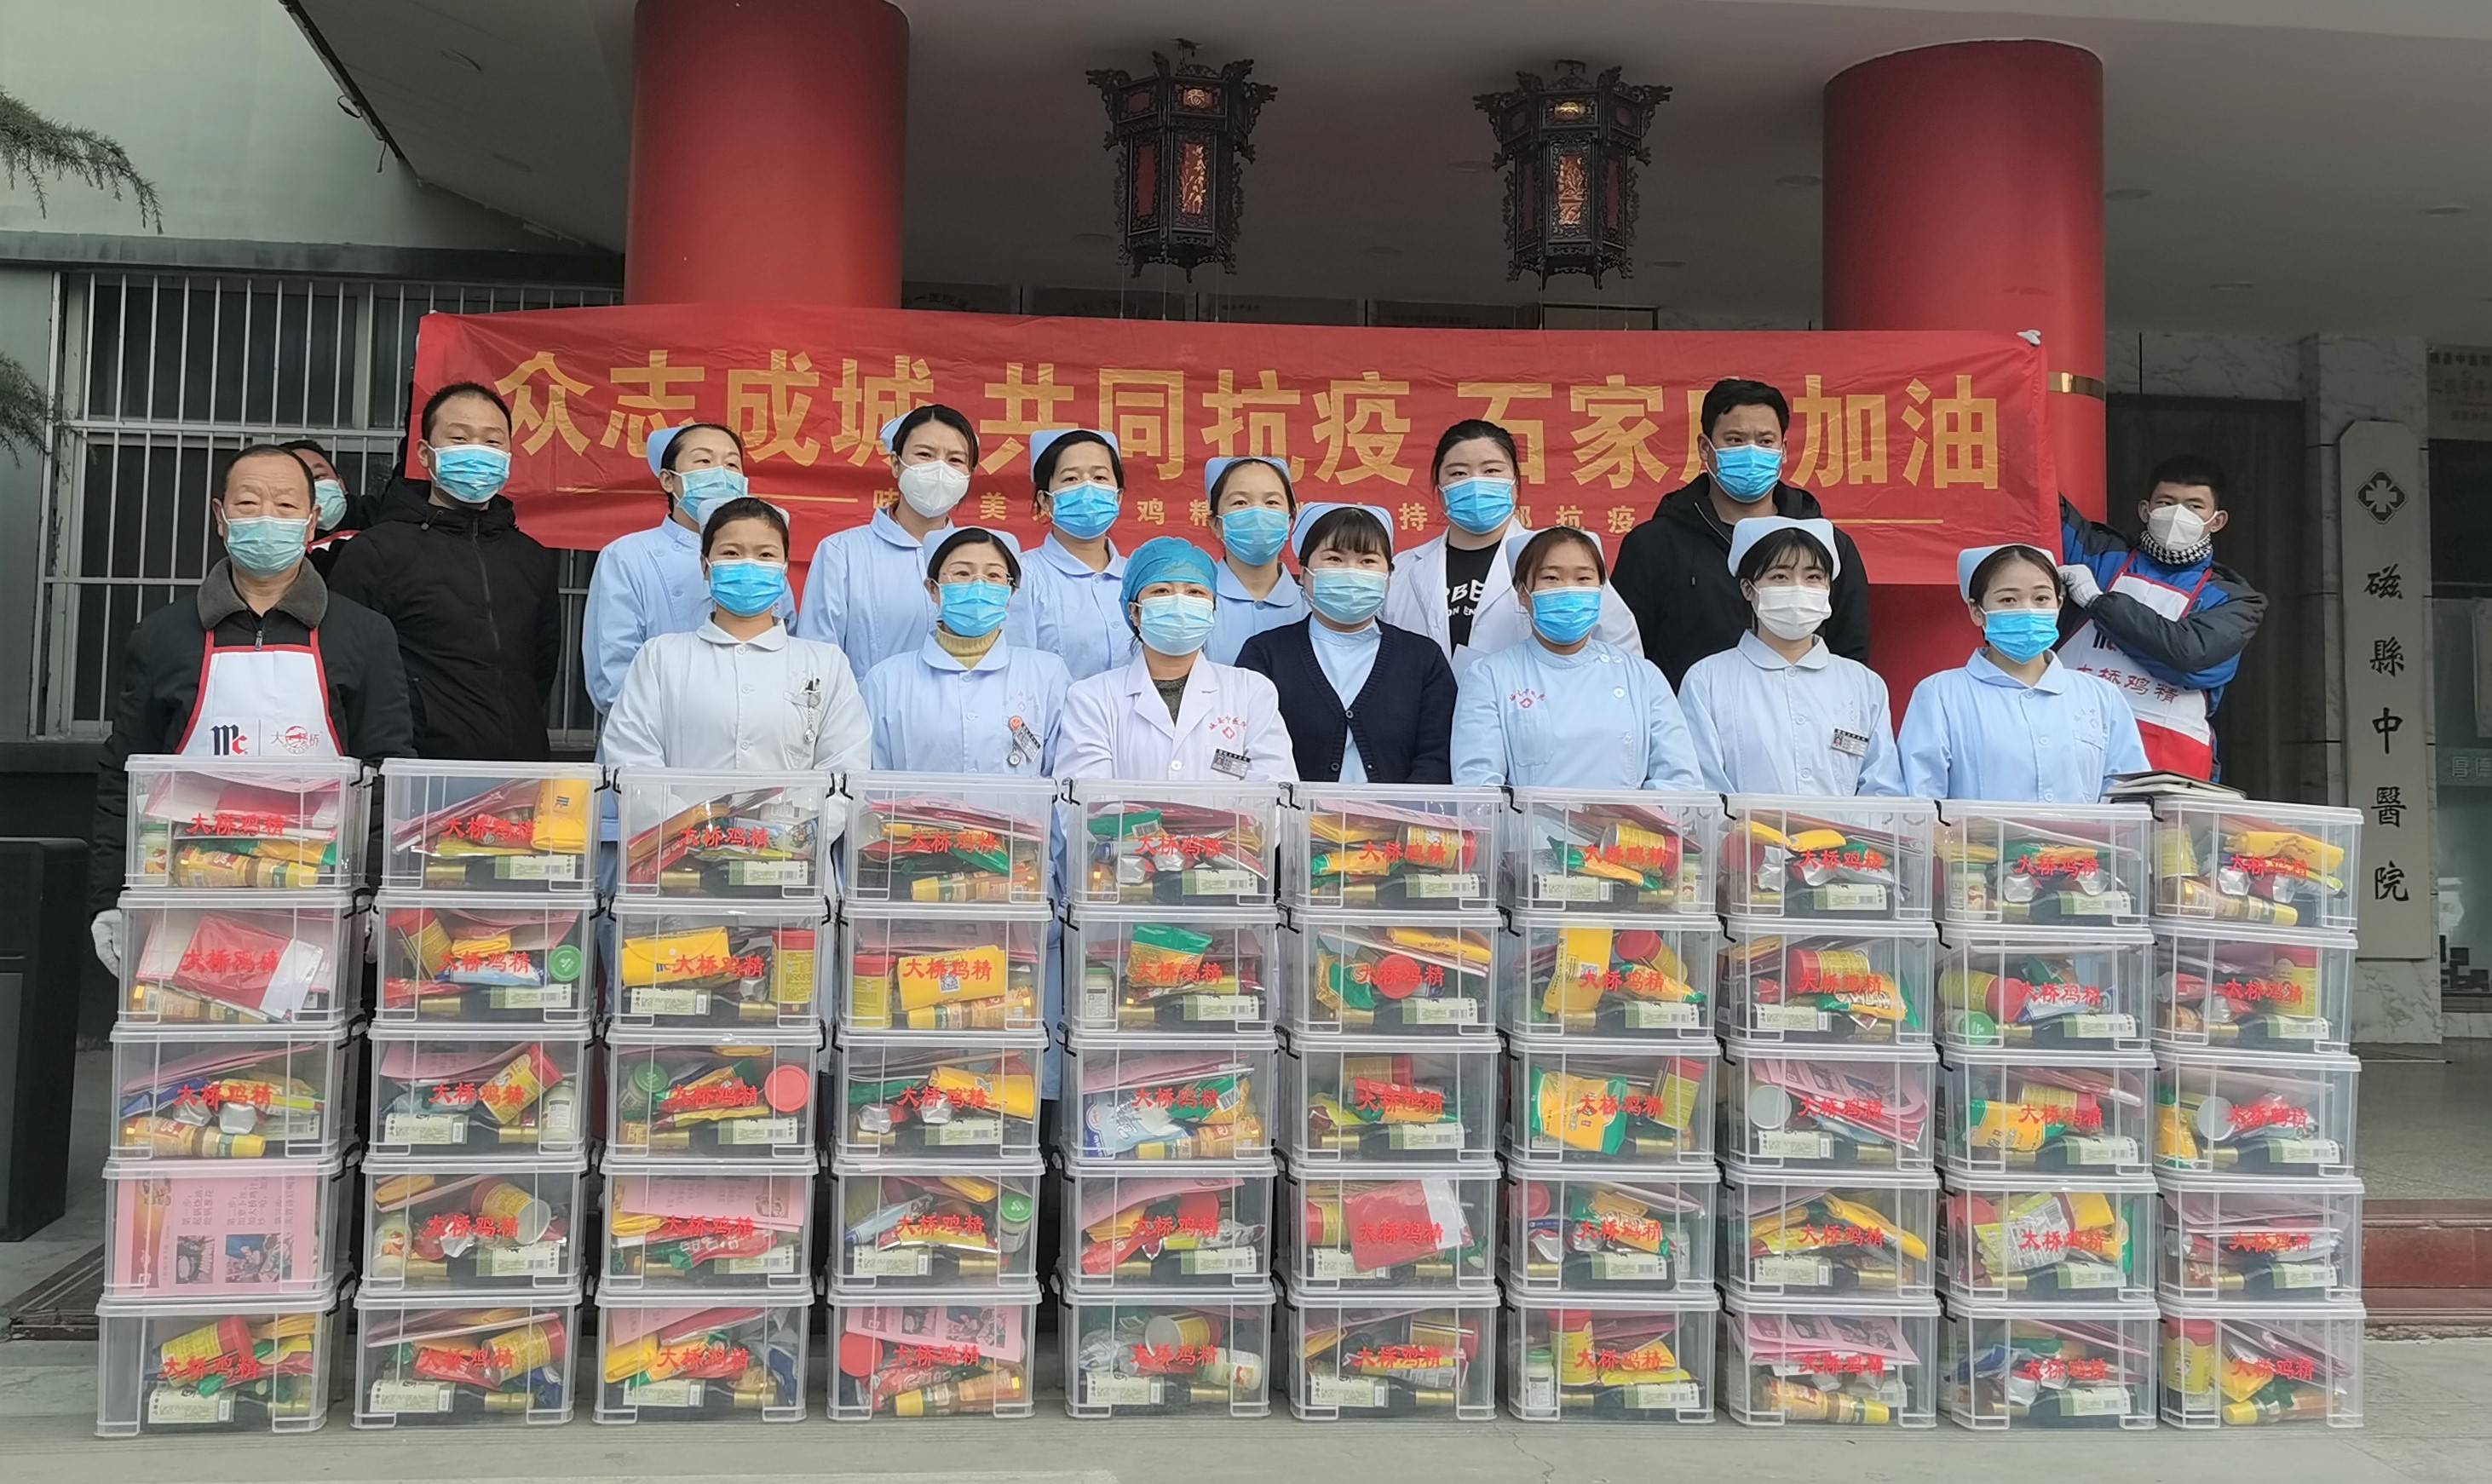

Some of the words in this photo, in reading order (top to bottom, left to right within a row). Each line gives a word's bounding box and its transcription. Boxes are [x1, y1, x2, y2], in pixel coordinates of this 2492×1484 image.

[494, 348, 934, 467] 众志成城
[979, 362, 1415, 486] 共同抗疫
[1457, 374, 1999, 489] 石家加油
[2363, 563, 2409, 902] 磁縣中醫院
[187, 813, 285, 837] 大桥鸡精
[681, 826, 768, 848] 大桥鸡精
[910, 831, 998, 853] 大桥鸡精
[1136, 835, 1222, 855] 大桥鸡精
[1360, 842, 1445, 862] 大桥鸡精
[1583, 845, 1667, 866] 大桥鸡精
[1798, 849, 1885, 871] 大桥鸡精
[2014, 856, 2098, 877] 大桥鸡精
[438, 952, 531, 974] 大桥鸡精
[673, 955, 764, 976] 大桥鸡精
[903, 958, 993, 981] 大桥鸡精
[1358, 965, 1445, 986] 大桥鸡精
[1579, 972, 1664, 992] 大桥鸡精
[2018, 982, 2100, 1004] 大桥鸡精
[174, 1085, 273, 1108] 大桥鸡精
[430, 1083, 525, 1106] 大桥鸡精
[900, 1087, 990, 1108] 大桥鸡精
[1131, 1088, 1217, 1108] 大桥鸡精
[1357, 1090, 1444, 1113] 大桥鸡精
[1576, 1096, 1664, 1117] 大桥鸡精
[1798, 1097, 1885, 1119] 大桥鸡精
[424, 1214, 519, 1239] 大桥鸡精
[664, 1215, 754, 1237] 大桥鸡精
[894, 1214, 984, 1235] 大桥鸡精
[1134, 1217, 1218, 1239] 大桥鸡精
[1577, 1219, 1663, 1242] 大桥鸡精
[1798, 1224, 1884, 1246] 大桥鸡精
[659, 1348, 749, 1369] 大桥鸡精
[893, 1345, 981, 1366] 大桥鸡精
[1357, 1346, 1444, 1367] 大桥鸡精
[1575, 1349, 1661, 1371] 大桥鸡精
[1799, 1353, 1884, 1376] 大桥鸡精
[162, 1358, 260, 1379] 大桥鸡精
[2231, 1359, 2315, 1379] 大桥鸡精
